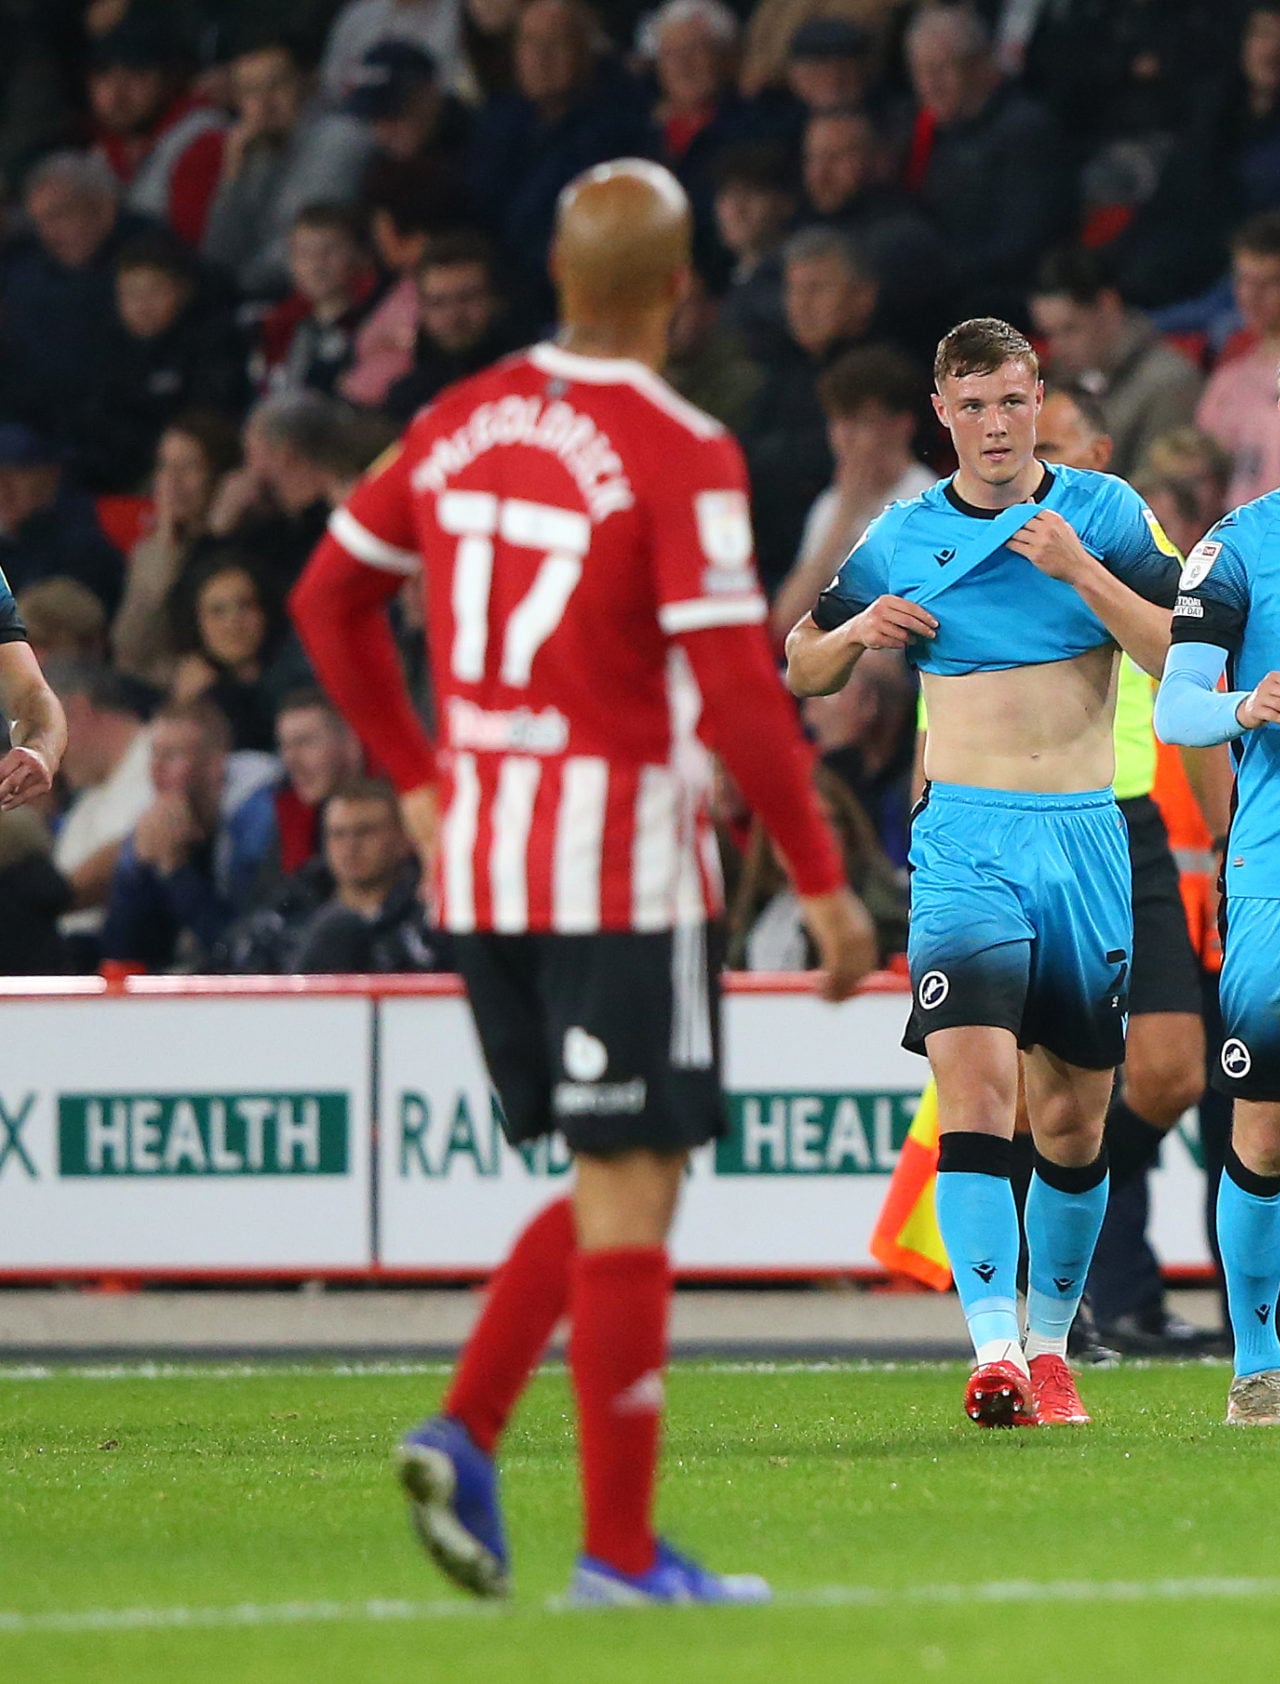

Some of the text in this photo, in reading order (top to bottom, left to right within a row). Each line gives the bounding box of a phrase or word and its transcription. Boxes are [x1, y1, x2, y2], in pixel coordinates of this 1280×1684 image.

[436, 489, 591, 688] 17
[86, 1098, 321, 1172] HEALTH
[742, 1096, 921, 1169] HEAL
